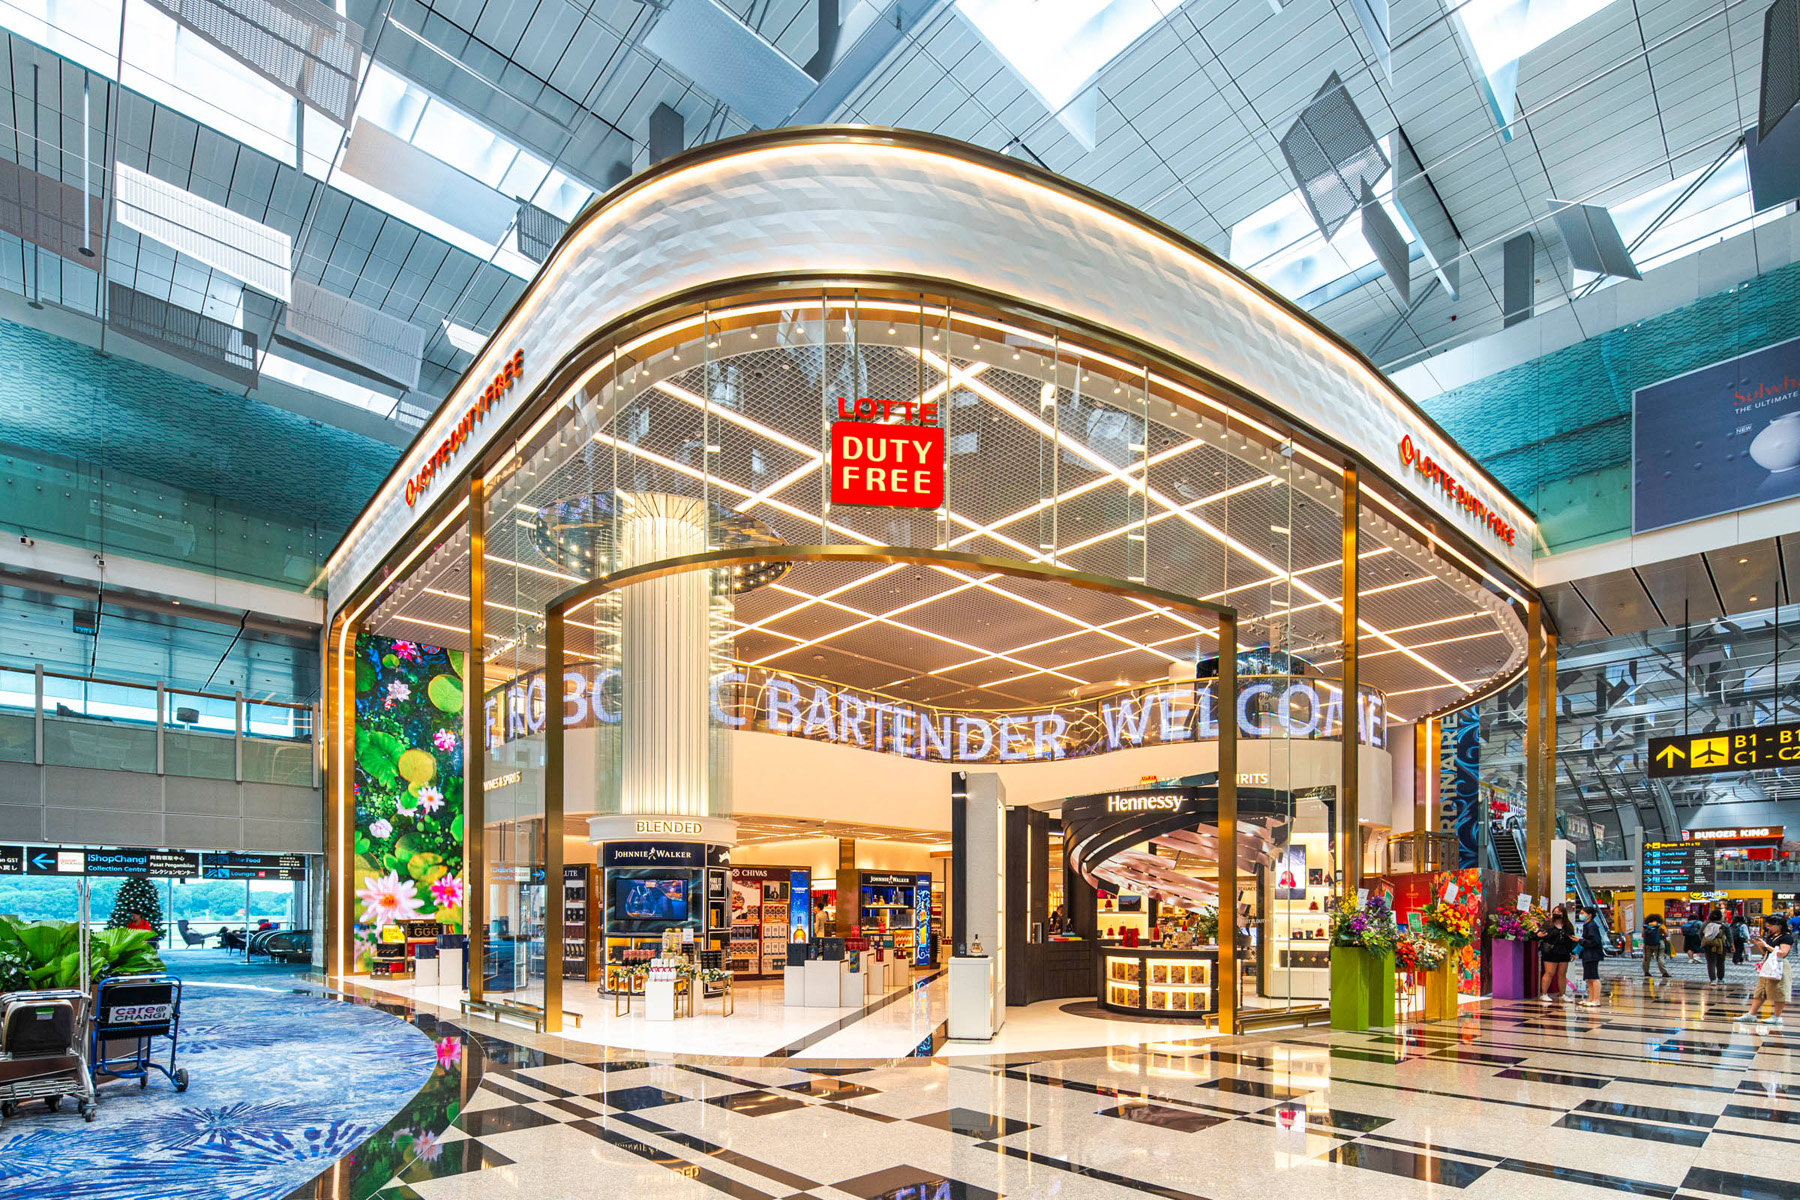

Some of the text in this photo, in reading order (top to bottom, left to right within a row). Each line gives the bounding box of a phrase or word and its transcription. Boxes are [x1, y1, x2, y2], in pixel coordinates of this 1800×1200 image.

[838, 396, 938, 424] LOTTE
[1735, 391, 1799, 415] THE ULTIMATE
[416, 348, 525, 492] LOTTE DUTY FREE
[1736, 426, 1752, 434] NEW
[843, 436, 933, 464] DUTY
[843, 466, 931, 494] FREE
[1415, 448, 1515, 546] LOTTE DUTY FREE
[507, 668, 746, 739] ROBOC
[765, 678, 1067, 761] BARTENDER
[1102, 683, 1383, 749] WELCOME
[1735, 734, 1757, 748] B1
[1734, 751, 1757, 764] C1
[1440, 713, 1458, 835] RDINAIRE
[1108, 795, 1184, 812] Hennessy
[636, 821, 702, 833] BLENDED
[1740, 829, 1769, 837] KING
[88, 854, 147, 864] iShopChangi
[614, 850, 691, 859] JOHNNIE WALKER
[115, 1006, 166, 1015] care@
[115, 1013, 166, 1021] CHANGI
